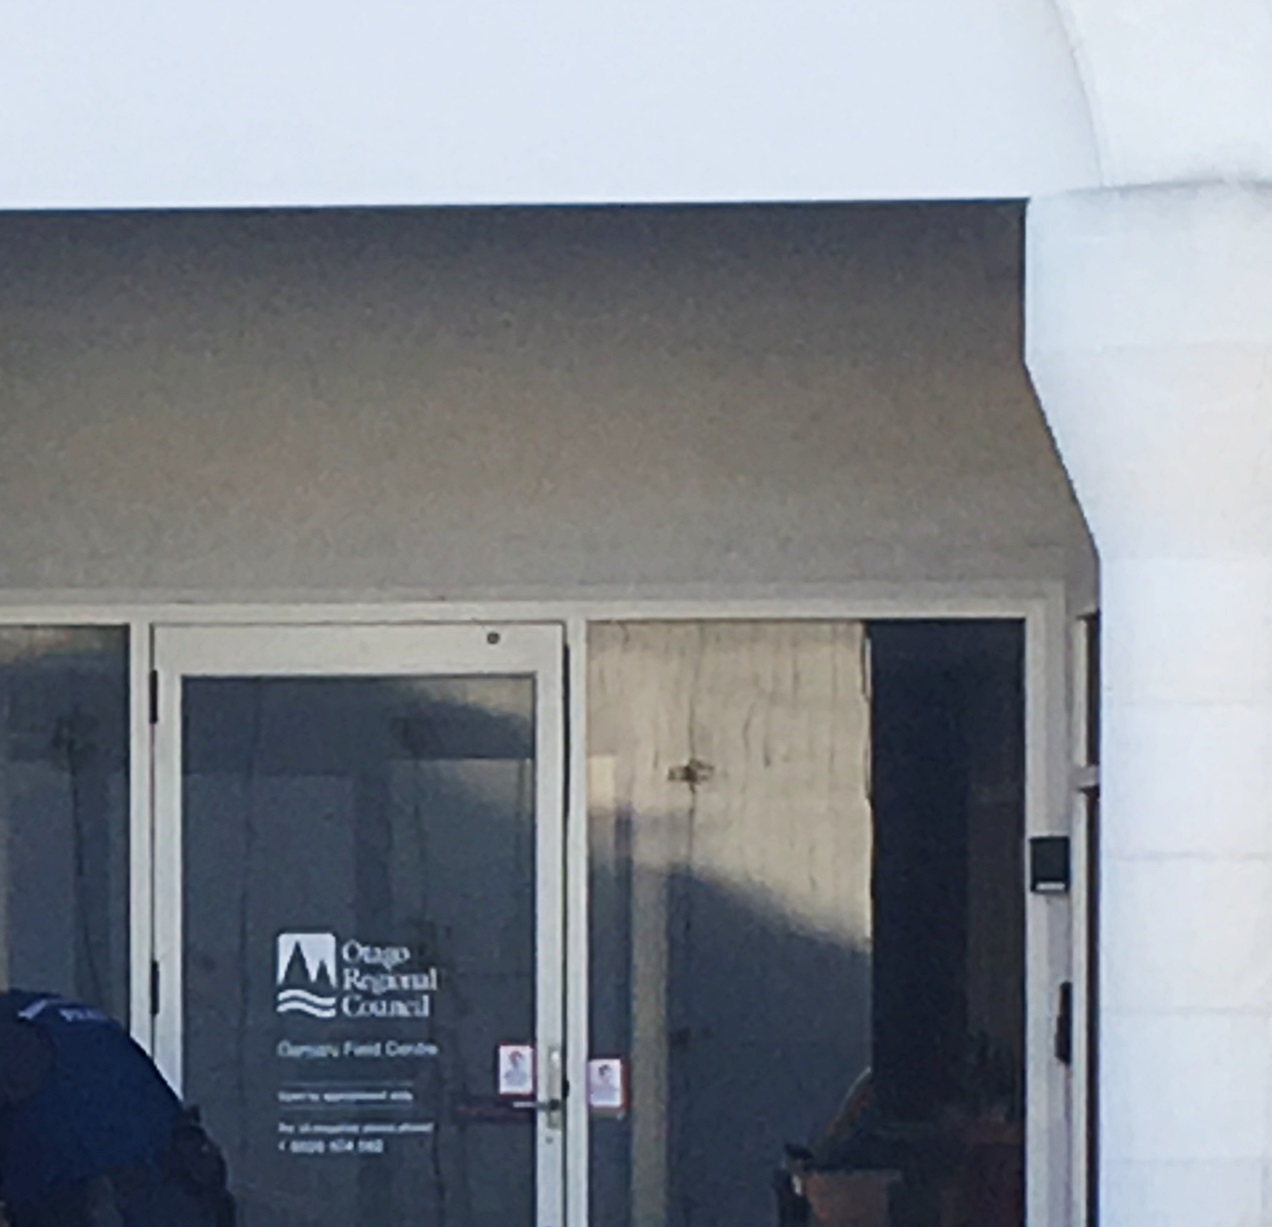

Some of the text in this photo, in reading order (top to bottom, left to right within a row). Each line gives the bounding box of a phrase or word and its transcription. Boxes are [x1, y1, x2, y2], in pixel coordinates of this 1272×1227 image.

[342, 940, 411, 970] Otago
[342, 967, 438, 994] Regional
[342, 993, 430, 1017] Council
